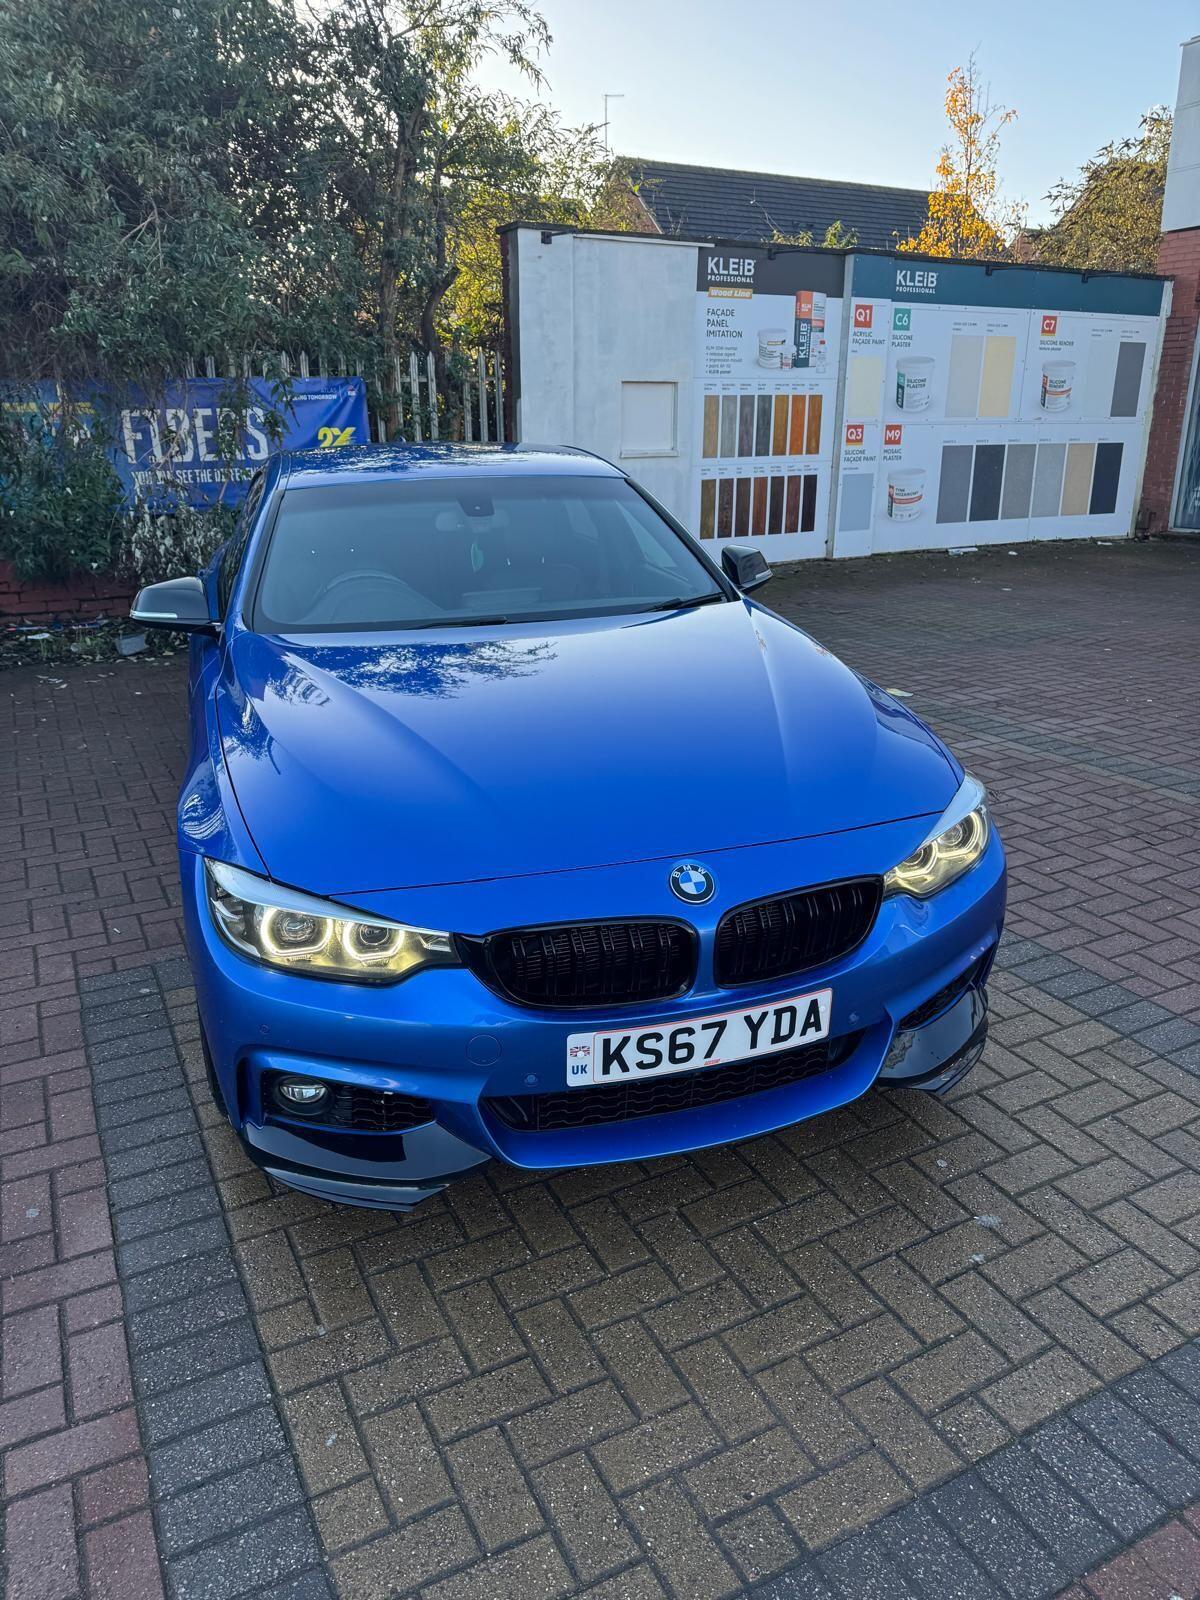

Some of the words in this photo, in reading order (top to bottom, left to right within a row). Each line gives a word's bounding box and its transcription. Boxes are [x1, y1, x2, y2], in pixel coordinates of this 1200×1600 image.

[707, 274, 754, 283] PROFESSIONAL
[895, 286, 936, 294] PROFESSIONAL
[856, 308, 871, 322] Q1
[895, 313, 909, 326] C6
[706, 318, 729, 328] PANEL
[1043, 319, 1055, 331] C7
[706, 329, 743, 339] IMITATION
[847, 428, 863, 441] Q3
[886, 429, 901, 441] M9
[176, 469, 194, 484] SEE
[195, 468, 213, 483] THE
[673, 864, 706, 878] BMW
[601, 1019, 728, 1076] KS67
[743, 998, 822, 1050] YDA
[571, 1064, 588, 1075] UK
